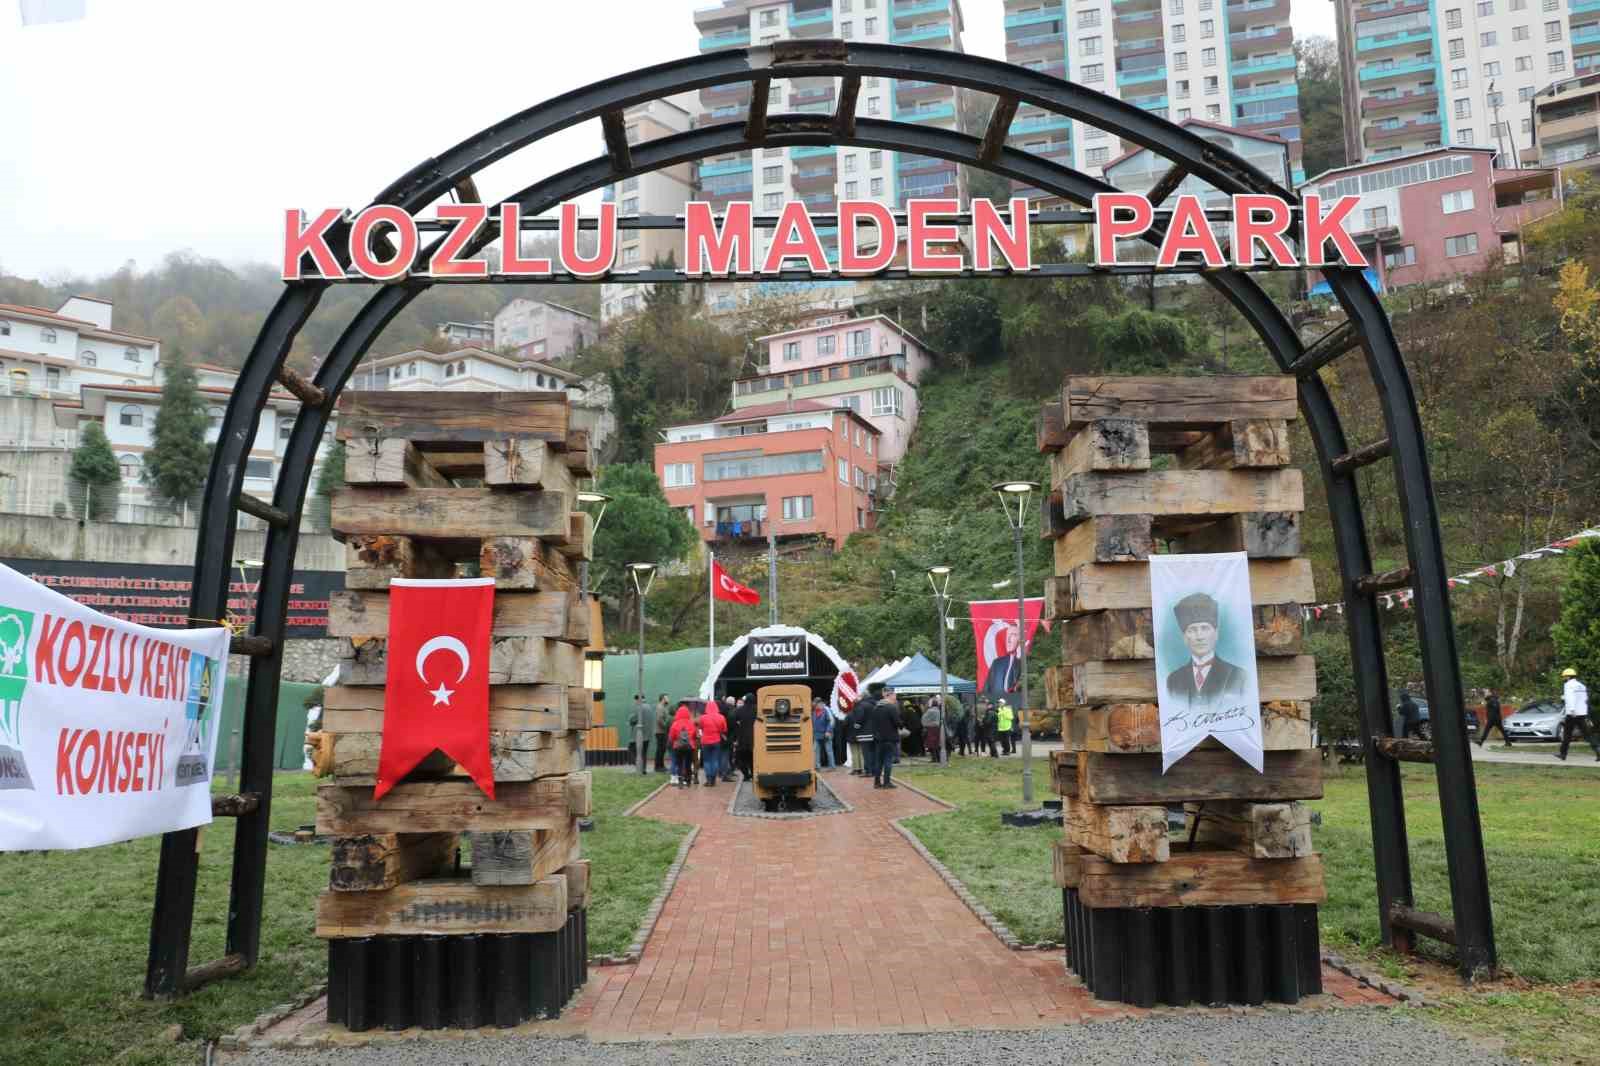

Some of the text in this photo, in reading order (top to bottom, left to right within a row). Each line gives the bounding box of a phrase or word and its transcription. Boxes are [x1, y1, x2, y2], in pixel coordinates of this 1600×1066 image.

[281, 193, 1369, 281] KOZLU MADEN PARK
[35, 614, 191, 702] KOZLU KENT
[753, 642, 800, 657] KOZLU
[56, 717, 169, 795] KONSEYİ
